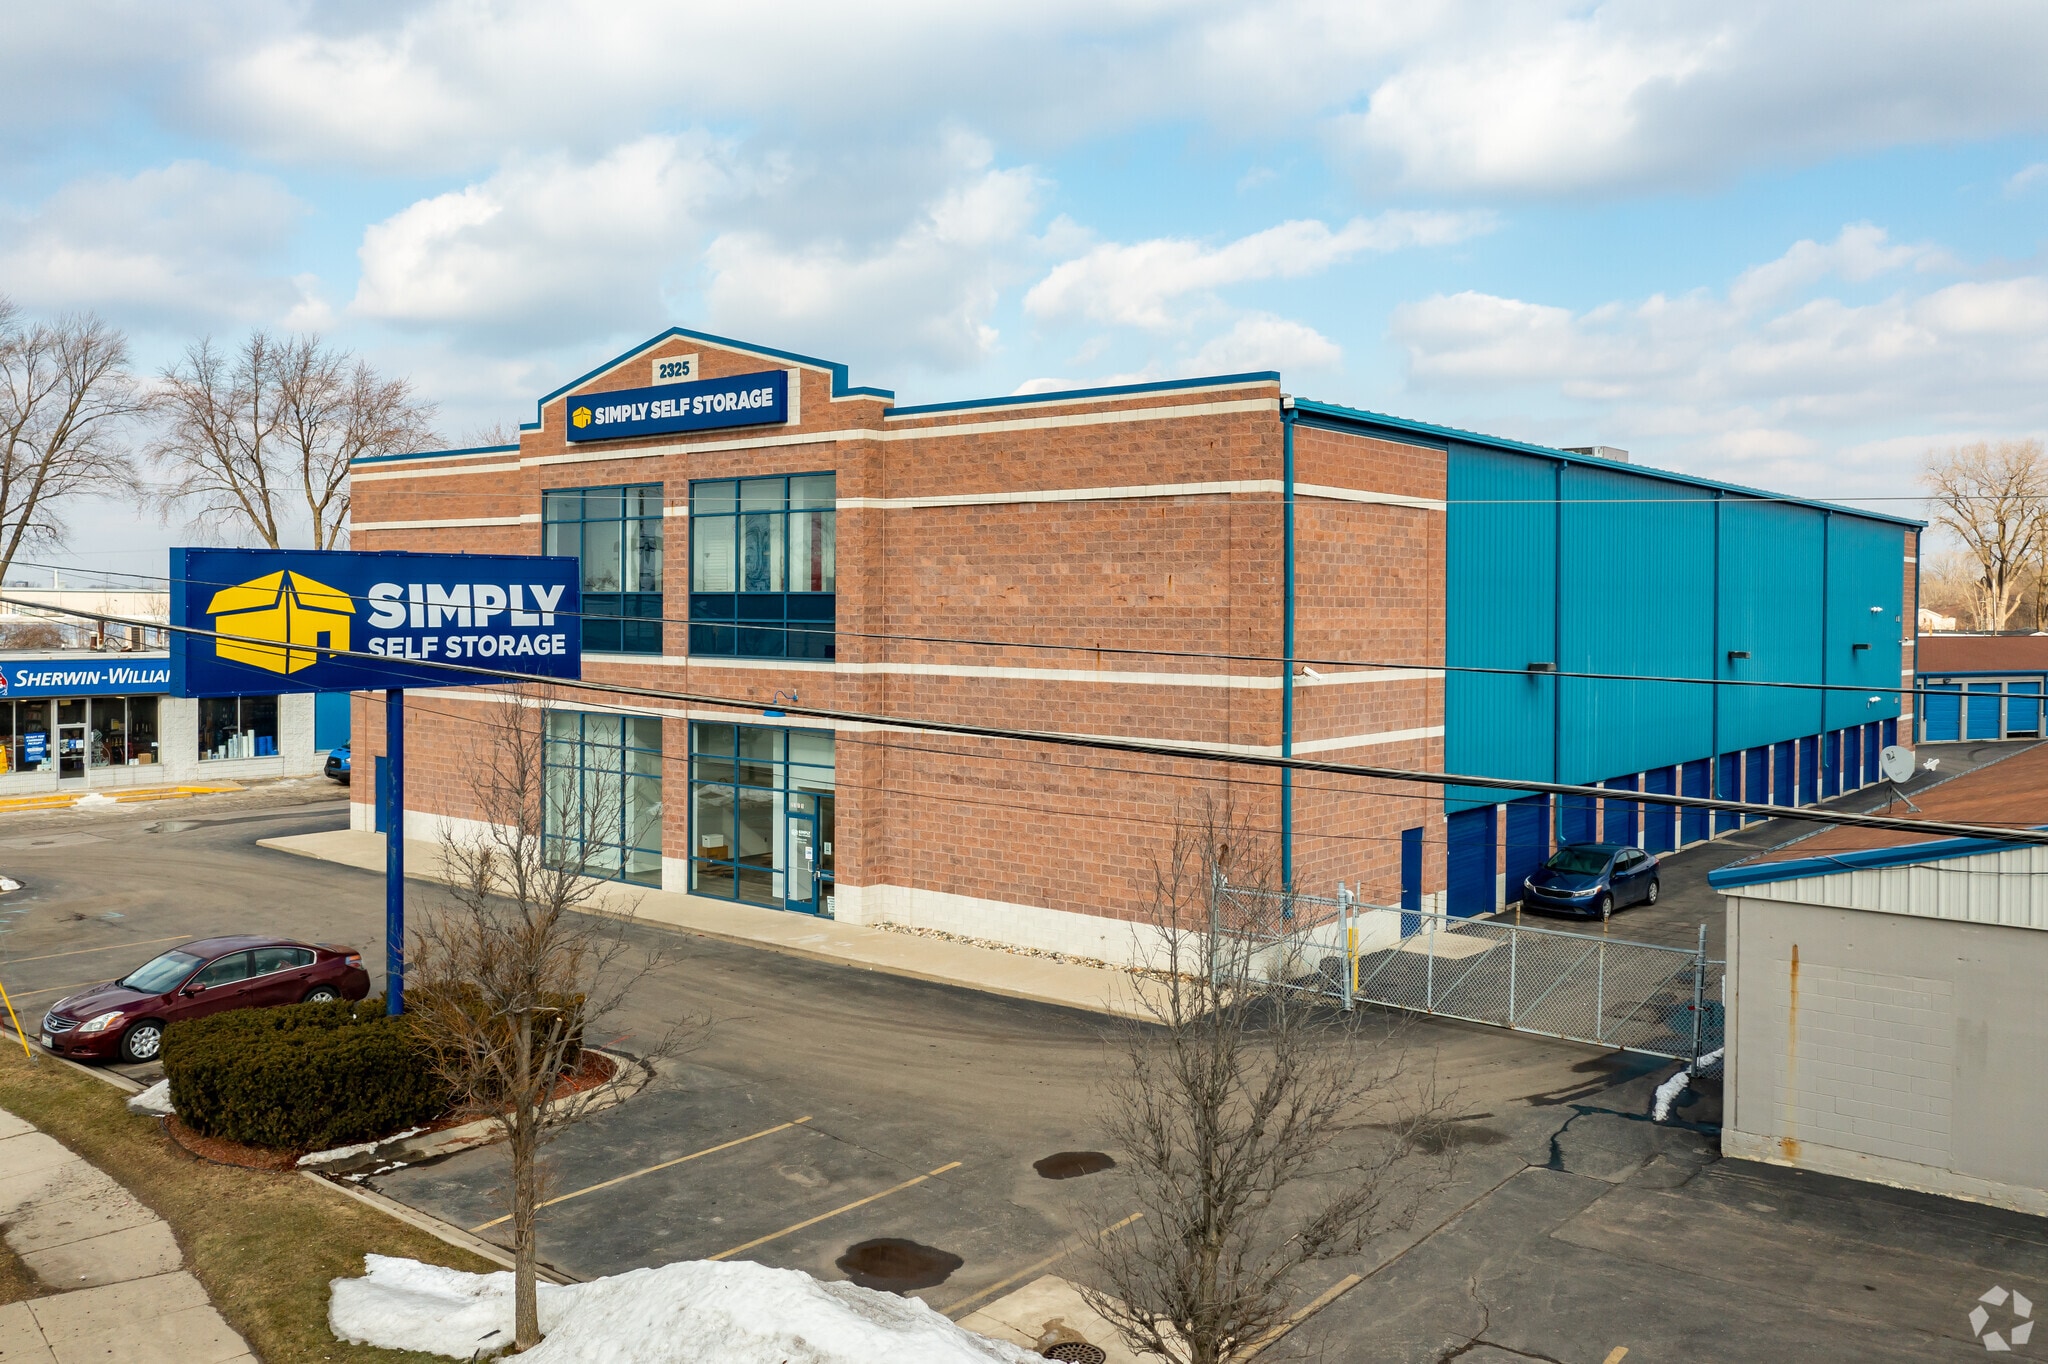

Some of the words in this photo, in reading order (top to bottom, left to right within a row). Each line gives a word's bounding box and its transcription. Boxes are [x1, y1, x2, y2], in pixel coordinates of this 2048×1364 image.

[659, 361, 690, 379] 2325
[594, 402, 649, 425] SIMPLY
[650, 397, 690, 419] SELF
[692, 387, 773, 415] STORAGE
[367, 582, 566, 629] SIMPLY
[368, 636, 439, 659] SELF
[445, 633, 566, 658] STORAGE
[14, 668, 170, 687] SHERWIN-WILLIA
